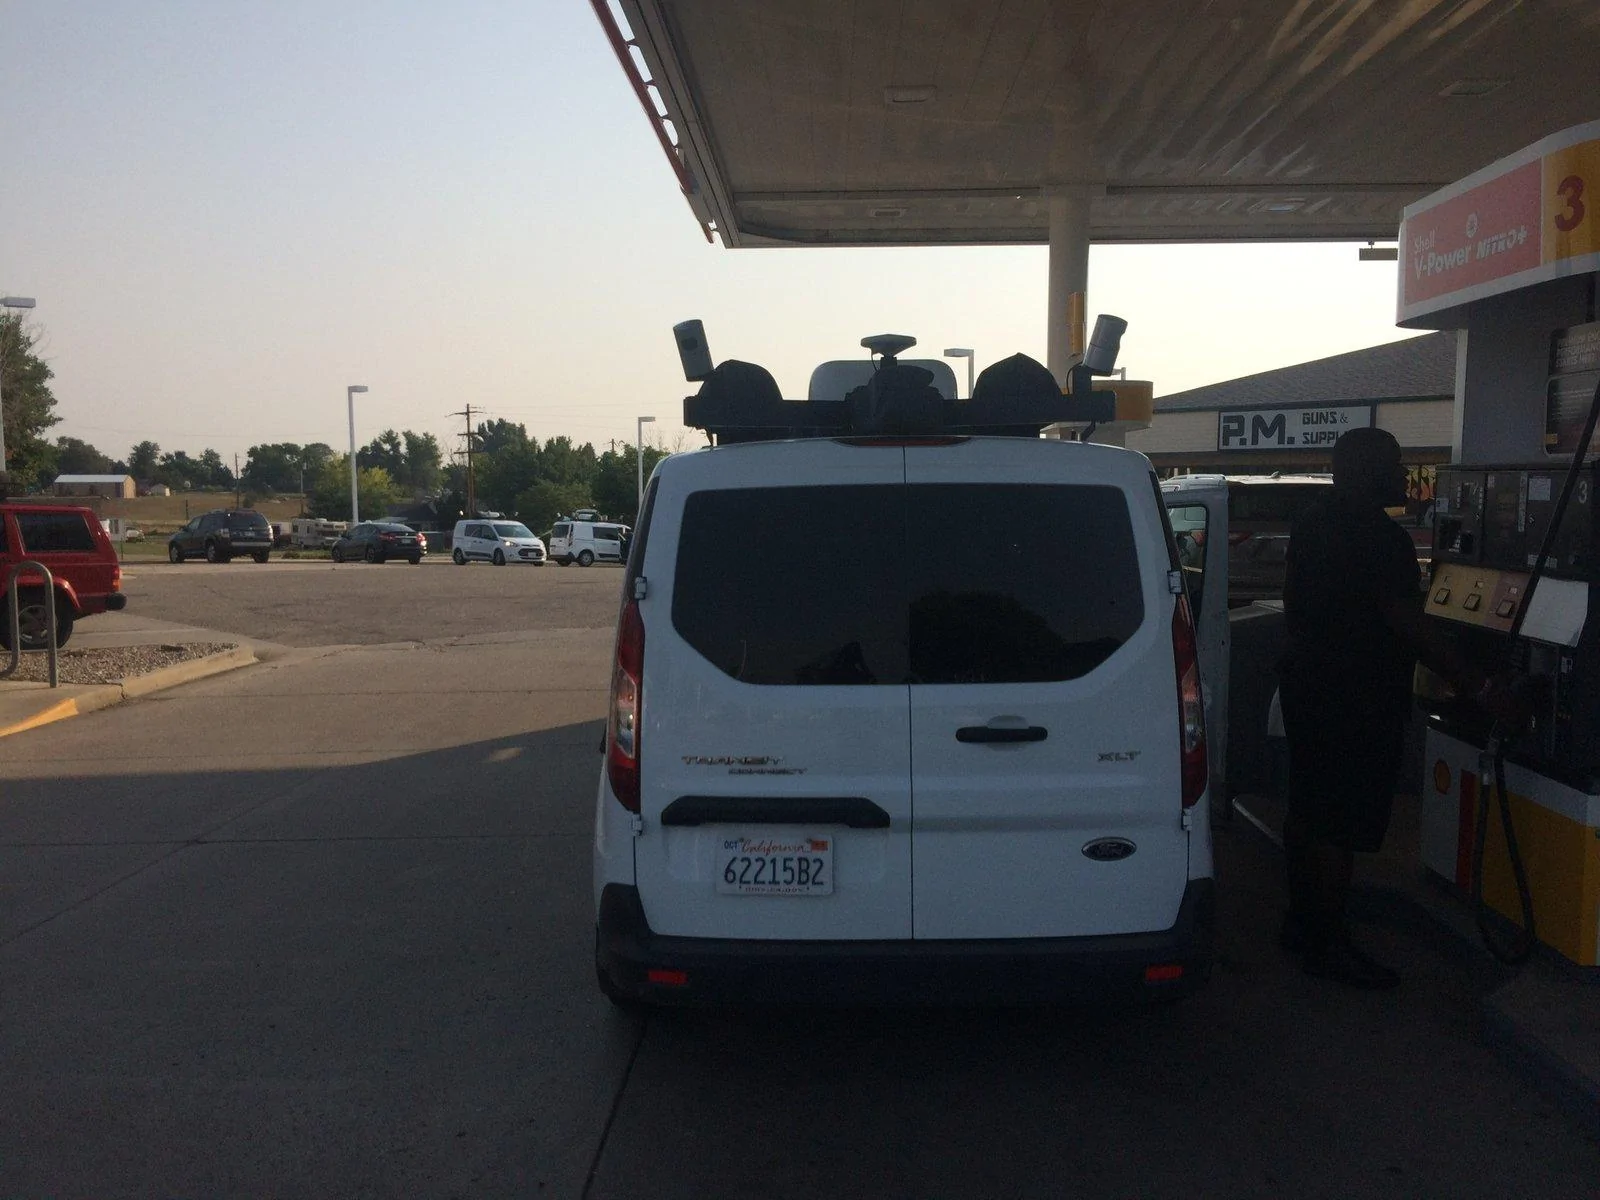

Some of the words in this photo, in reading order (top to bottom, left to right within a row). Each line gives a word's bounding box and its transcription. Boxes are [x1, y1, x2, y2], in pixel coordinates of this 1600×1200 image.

[1554, 175, 1586, 232] 3
[1413, 229, 1436, 254] Shell
[1414, 244, 1472, 281] V-Power
[1222, 413, 1296, 447] P.M.
[1302, 411, 1338, 425] GUNS
[1339, 411, 1349, 424] &
[1577, 480, 1588, 504] 3
[1096, 750, 1142, 763] XLT
[723, 839, 738, 850] OCT
[741, 838, 805, 857] California
[723, 856, 825, 886] 62215B2
